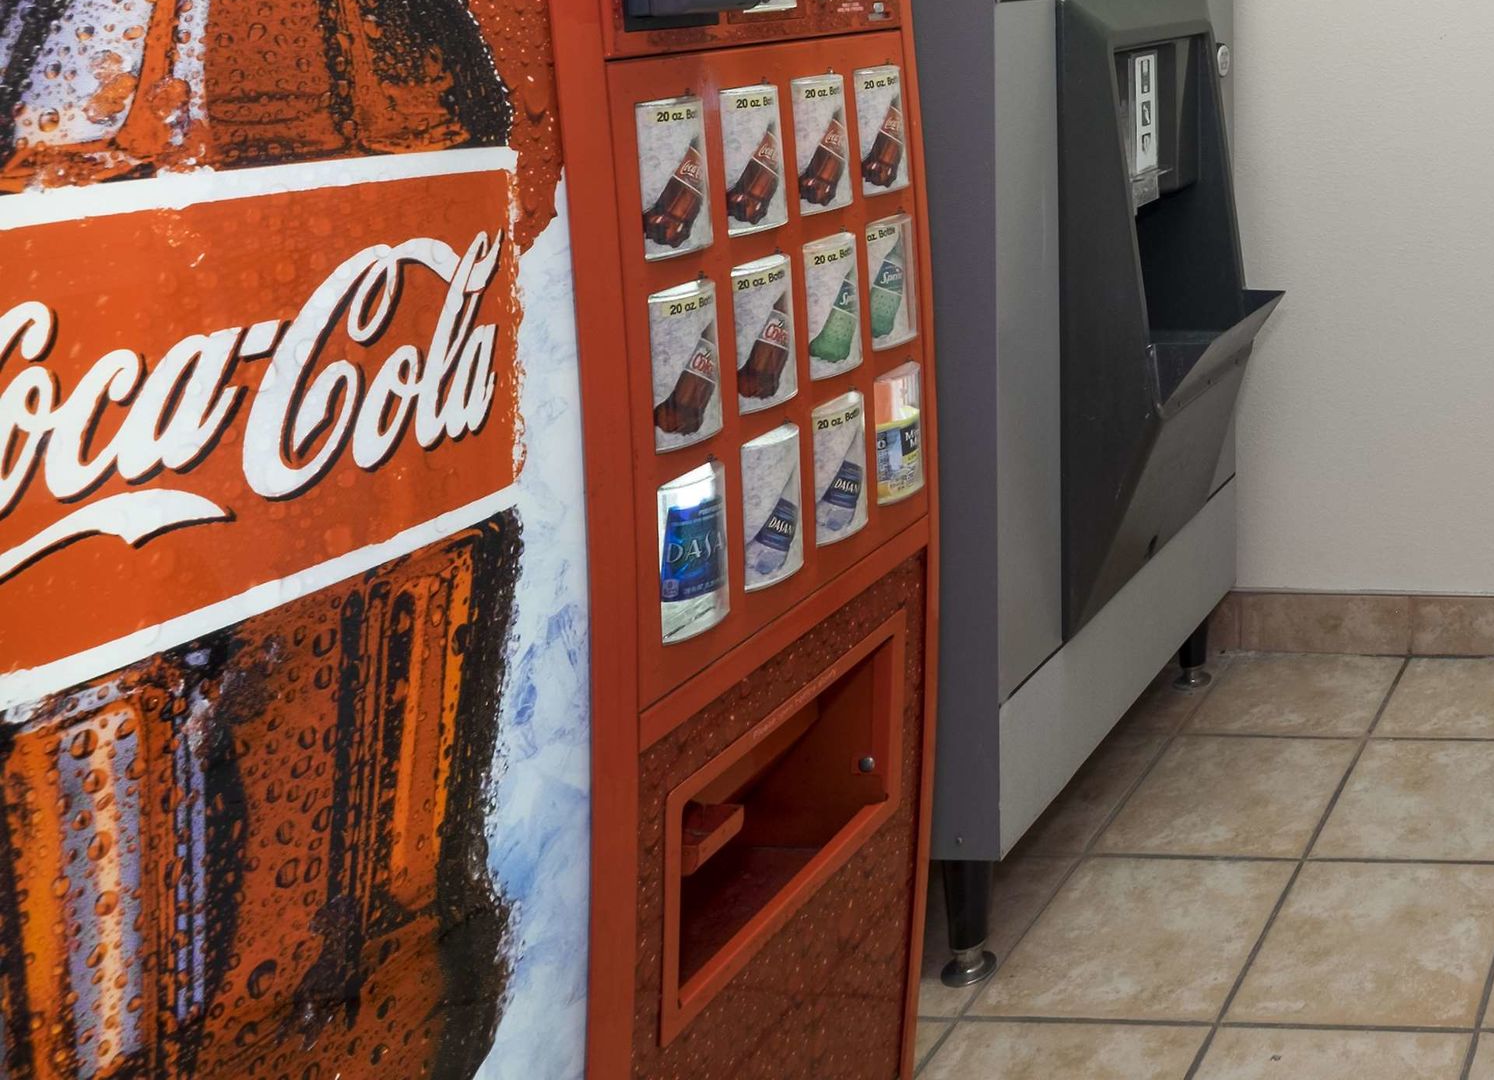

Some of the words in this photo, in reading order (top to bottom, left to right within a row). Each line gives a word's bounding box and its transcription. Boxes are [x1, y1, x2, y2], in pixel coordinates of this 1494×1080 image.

[863, 80, 875, 89] 20
[805, 89, 815, 98] 20
[736, 99, 748, 109] 20
[656, 111, 669, 122] 20
[814, 255, 825, 265] 20
[737, 280, 750, 290] 20
[670, 304, 682, 315] 20
[817, 419, 828, 430] 20
